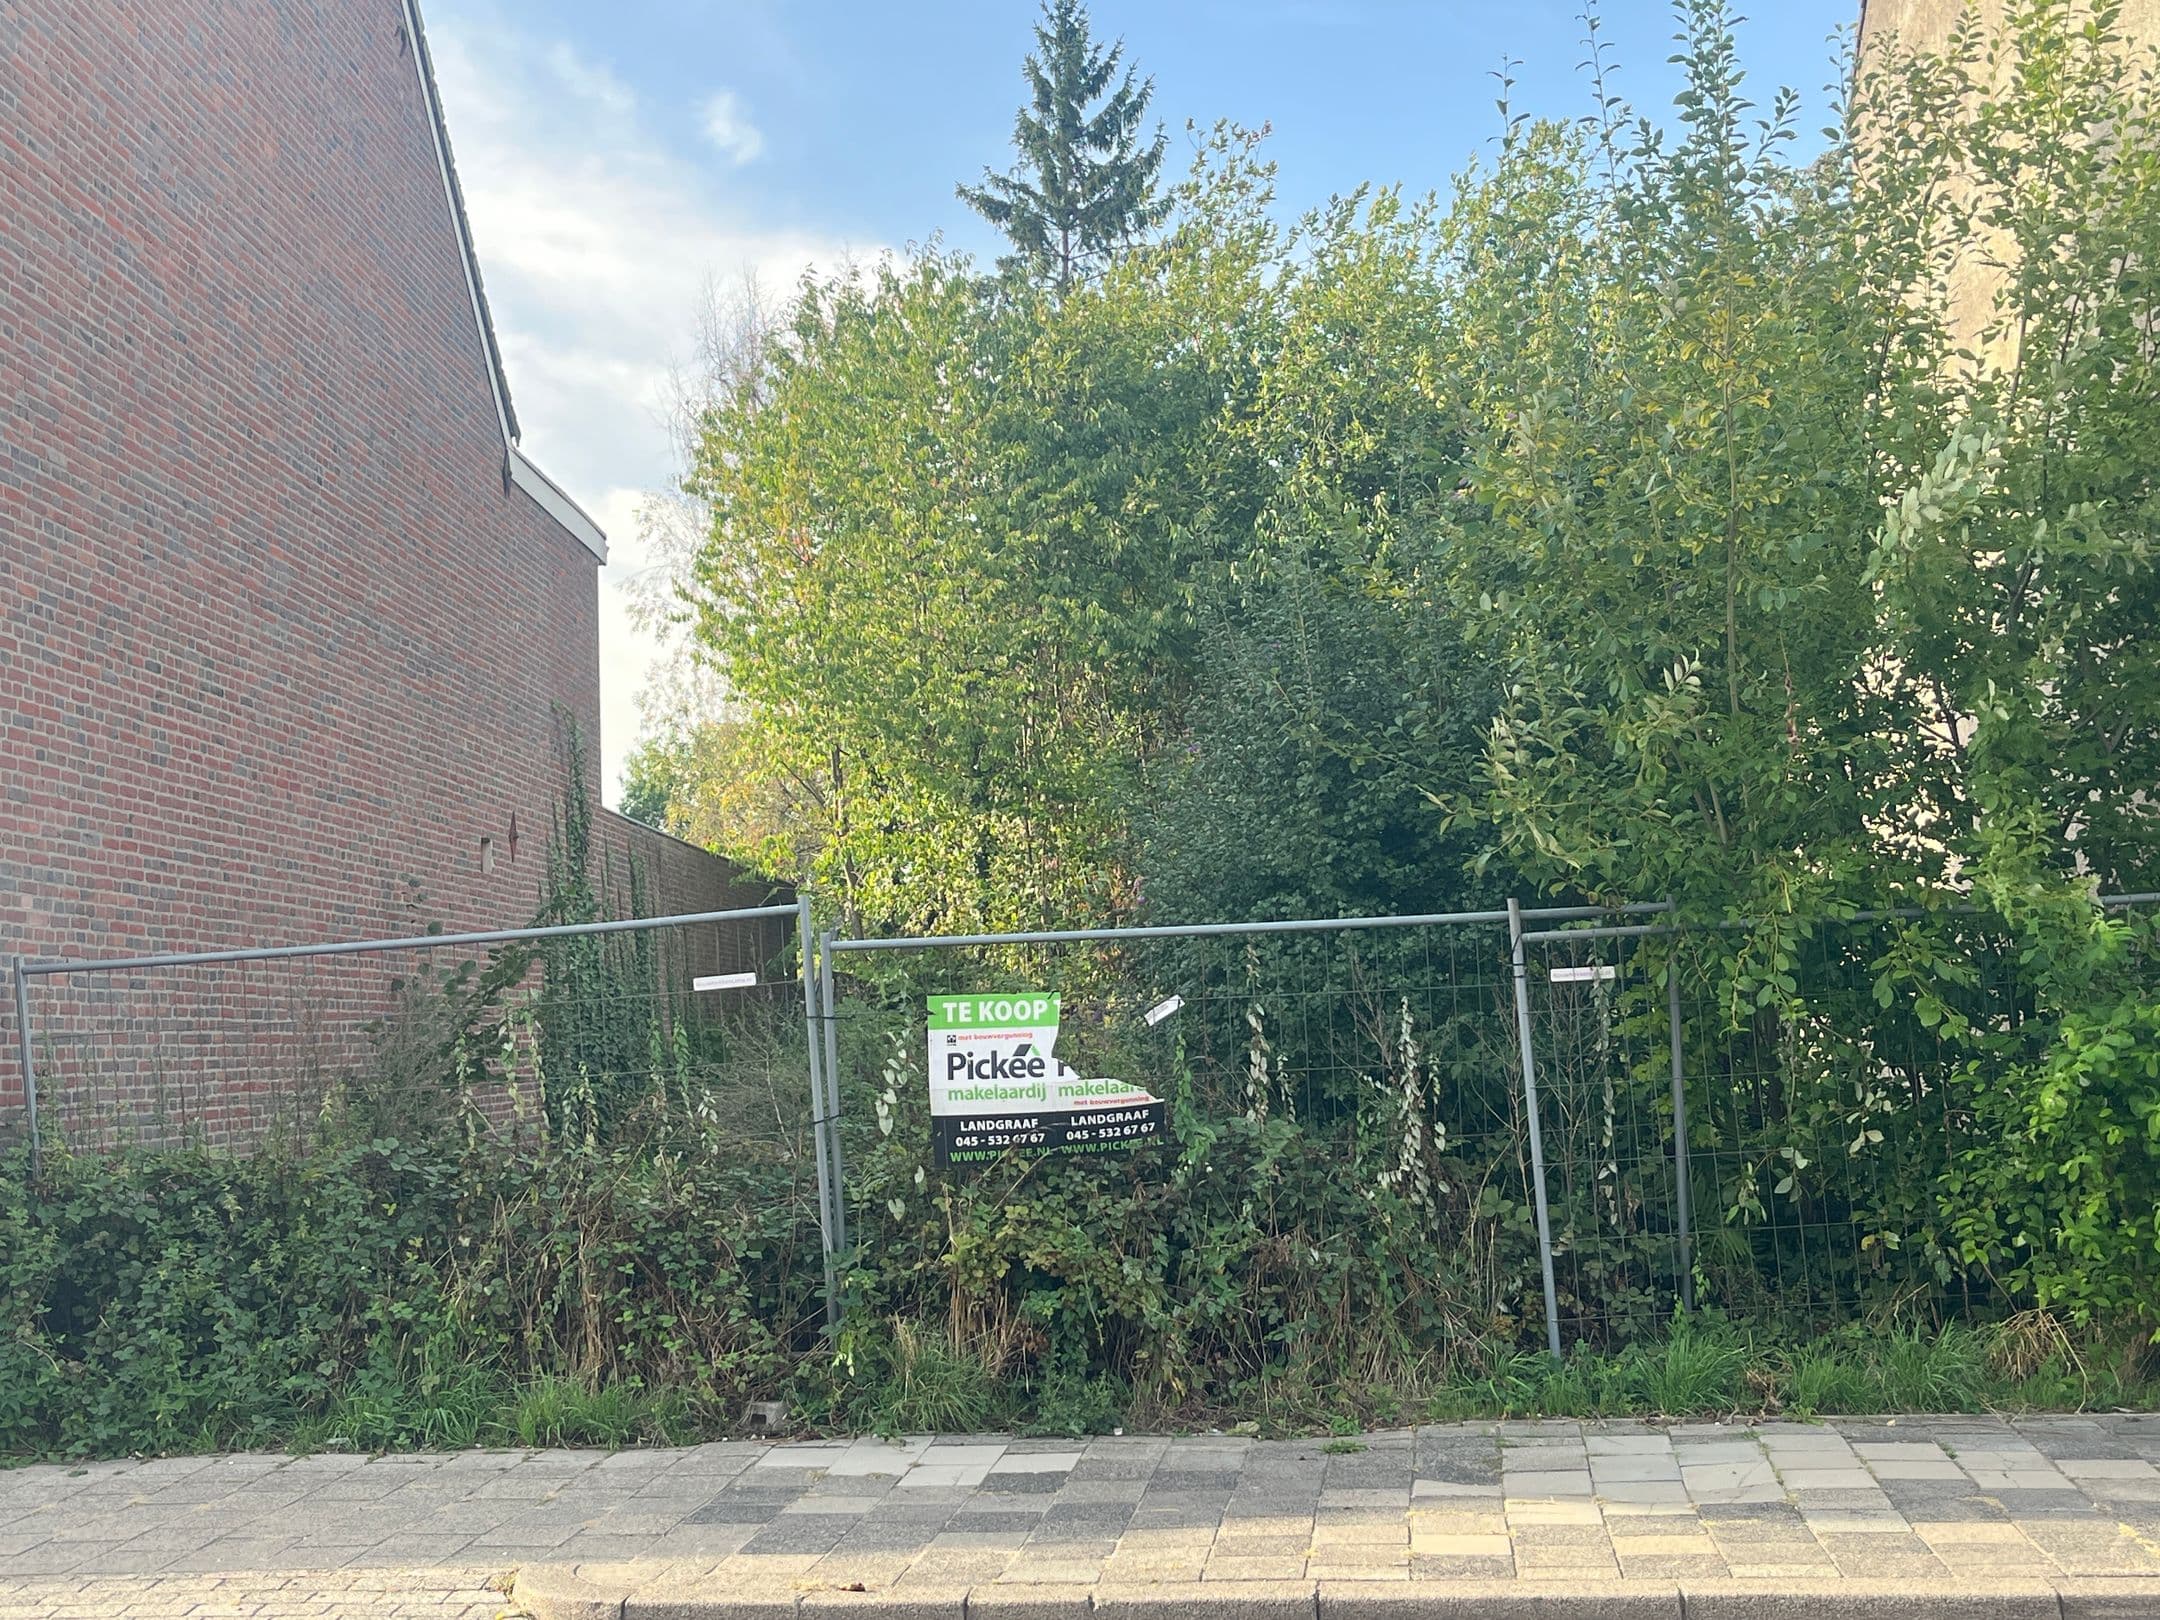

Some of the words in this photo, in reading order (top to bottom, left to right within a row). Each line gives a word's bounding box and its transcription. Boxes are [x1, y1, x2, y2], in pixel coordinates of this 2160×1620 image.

[942, 1001, 972, 1023] TE
[978, 999, 1048, 1022] KOOP
[948, 1082, 1047, 1102] makelaardij
[960, 1119, 1039, 1132] LANDGRAAF
[1070, 1109, 1150, 1127] LANDGRAAF
[955, 1136, 979, 1147] 045
[987, 1135, 1010, 1146] 532
[1013, 1133, 1028, 1144] 67
[1029, 1132, 1046, 1143] 67
[1066, 1130, 1090, 1141] 045
[1098, 1127, 1122, 1138] 532
[1122, 1124, 1139, 1136] 67
[1140, 1121, 1156, 1133] 67
